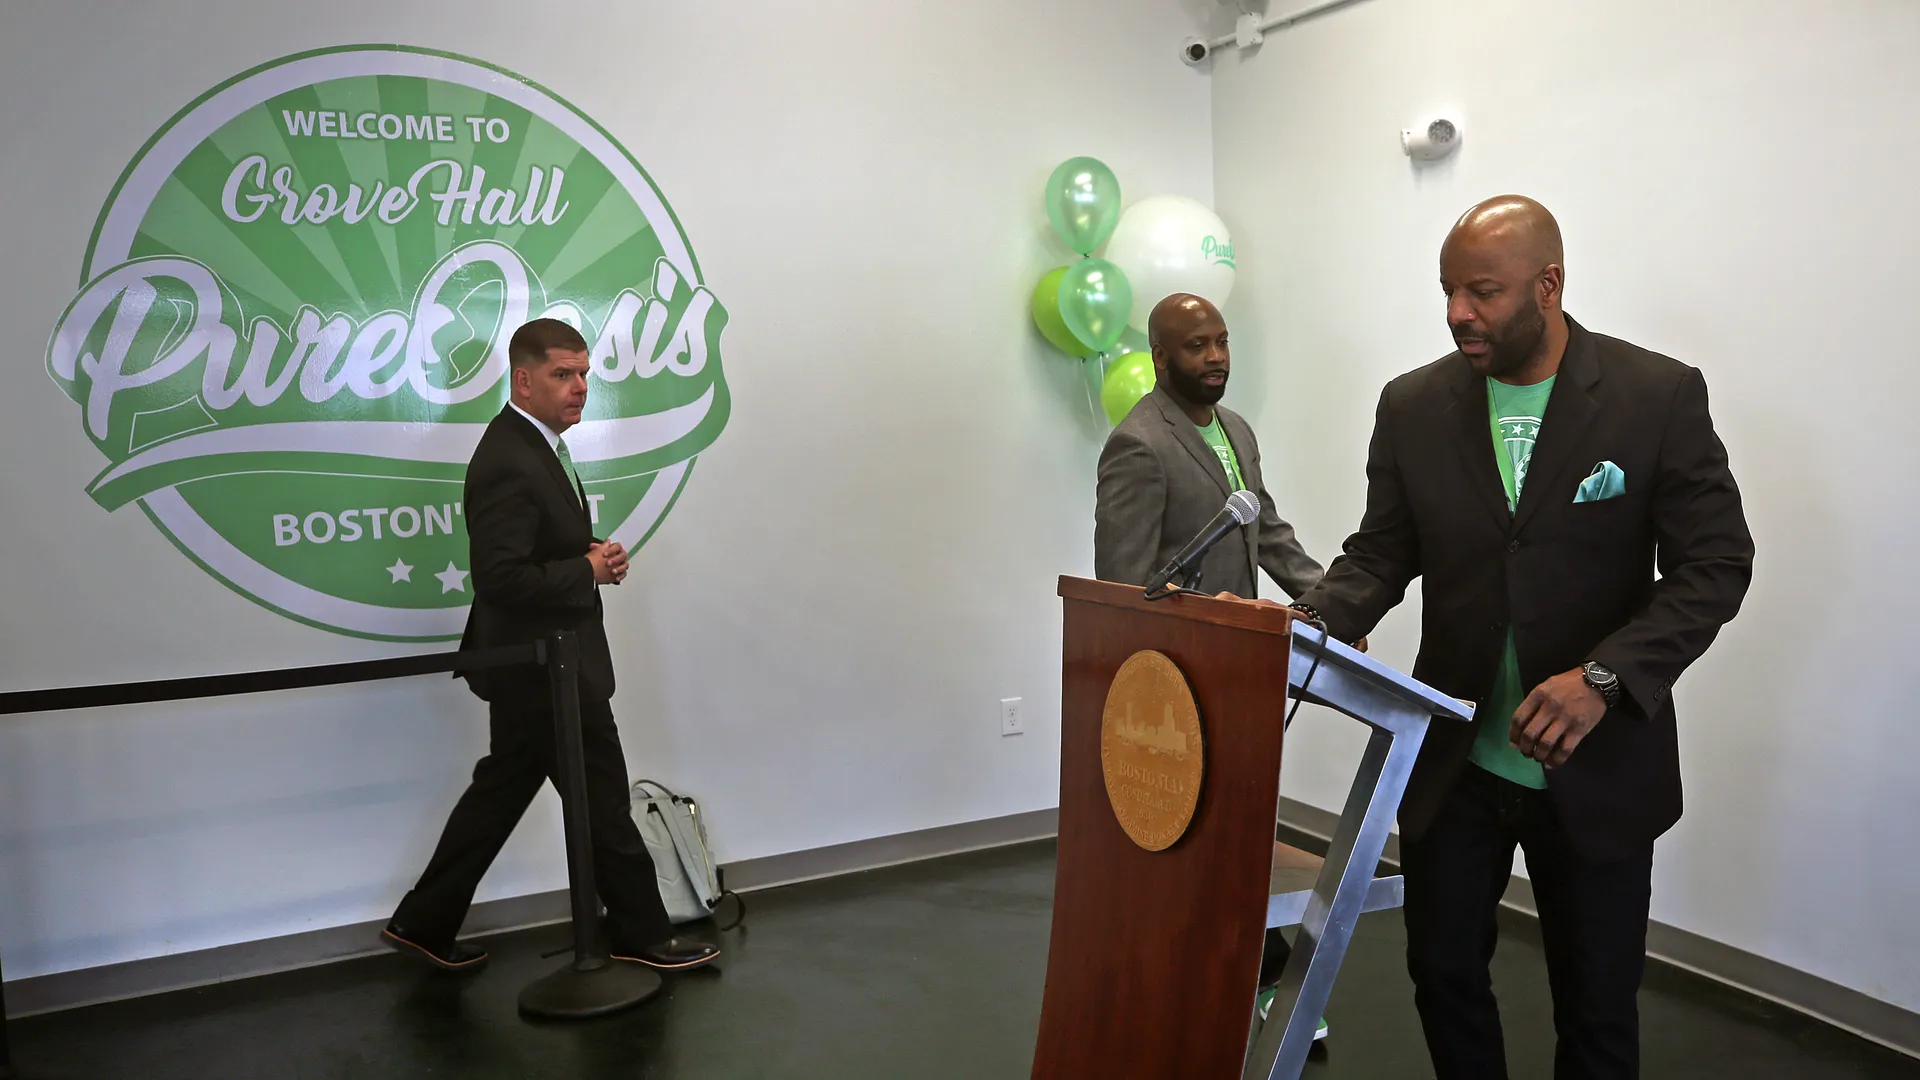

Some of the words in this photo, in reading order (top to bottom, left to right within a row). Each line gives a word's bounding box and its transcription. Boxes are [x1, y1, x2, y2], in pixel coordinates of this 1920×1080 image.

[282, 109, 454, 141] WELCOME
[466, 117, 510, 143] TO
[273, 503, 463, 546] BOSTON'
